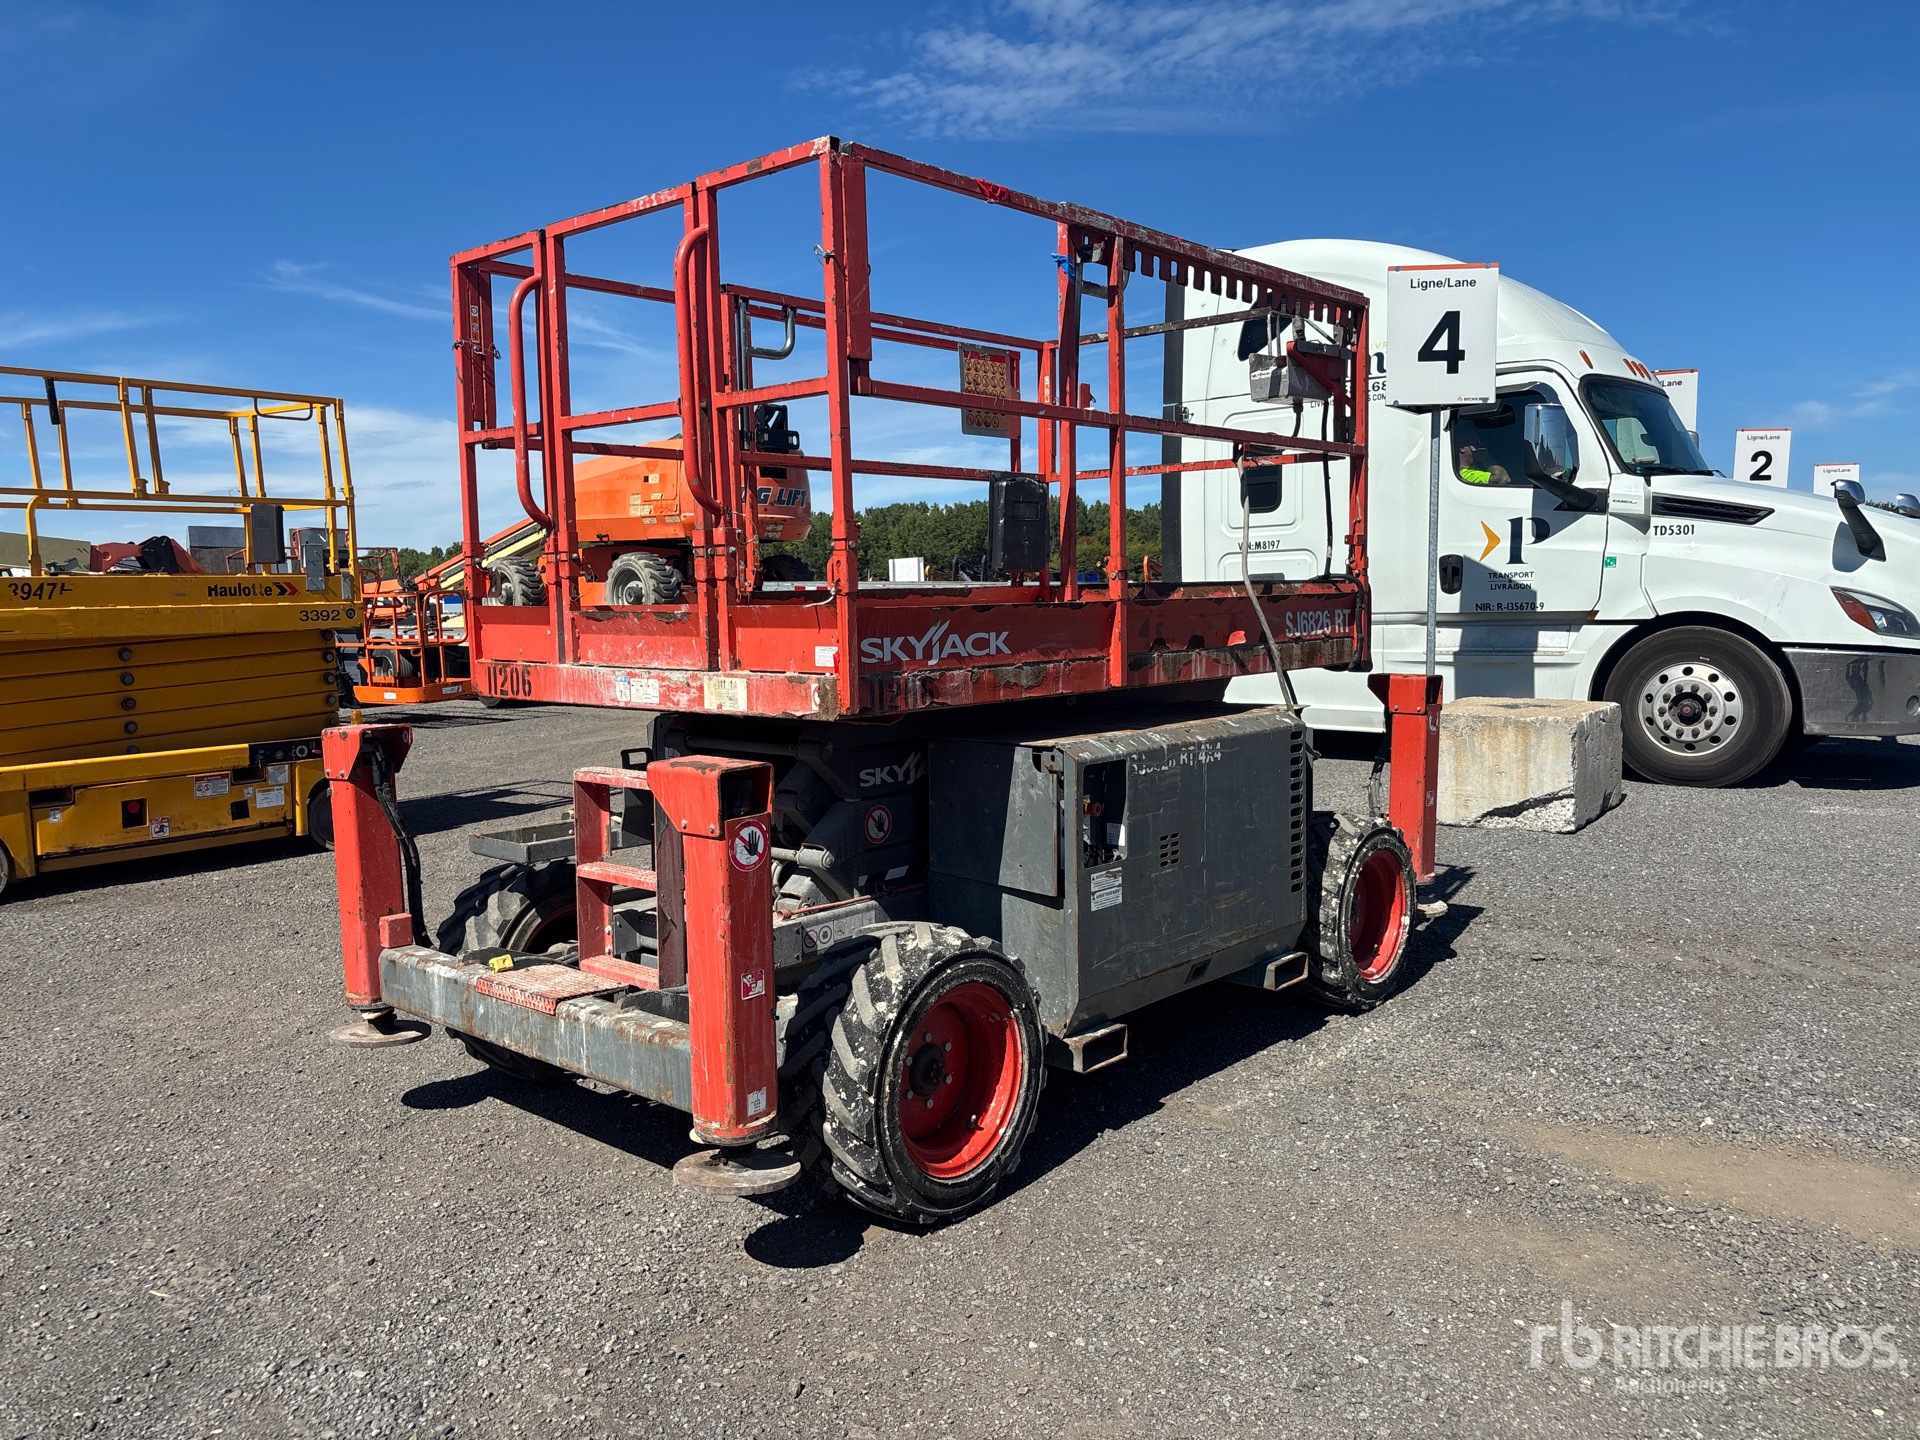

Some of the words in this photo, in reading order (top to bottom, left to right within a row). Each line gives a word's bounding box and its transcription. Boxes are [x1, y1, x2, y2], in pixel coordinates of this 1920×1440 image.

[1410, 278, 1477, 291] Ligne/Lane
[1417, 310, 1466, 375] 4
[1749, 450, 1773, 481] 2
[777, 488, 807, 508] LIFT
[1506, 516, 1551, 565] P
[1653, 524, 1695, 536] TD5301
[1237, 539, 1281, 551] VN:M8197
[1488, 571, 1534, 579] TRANSPORT
[299, 609, 341, 622] 3392
[1475, 603, 1495, 611] NIR:
[1285, 610, 1332, 637] SJ6826
[1334, 609, 1351, 633] RT
[860, 619, 1012, 666] SKYJACK
[487, 665, 532, 697] 11206
[859, 750, 929, 787] SKYJ
